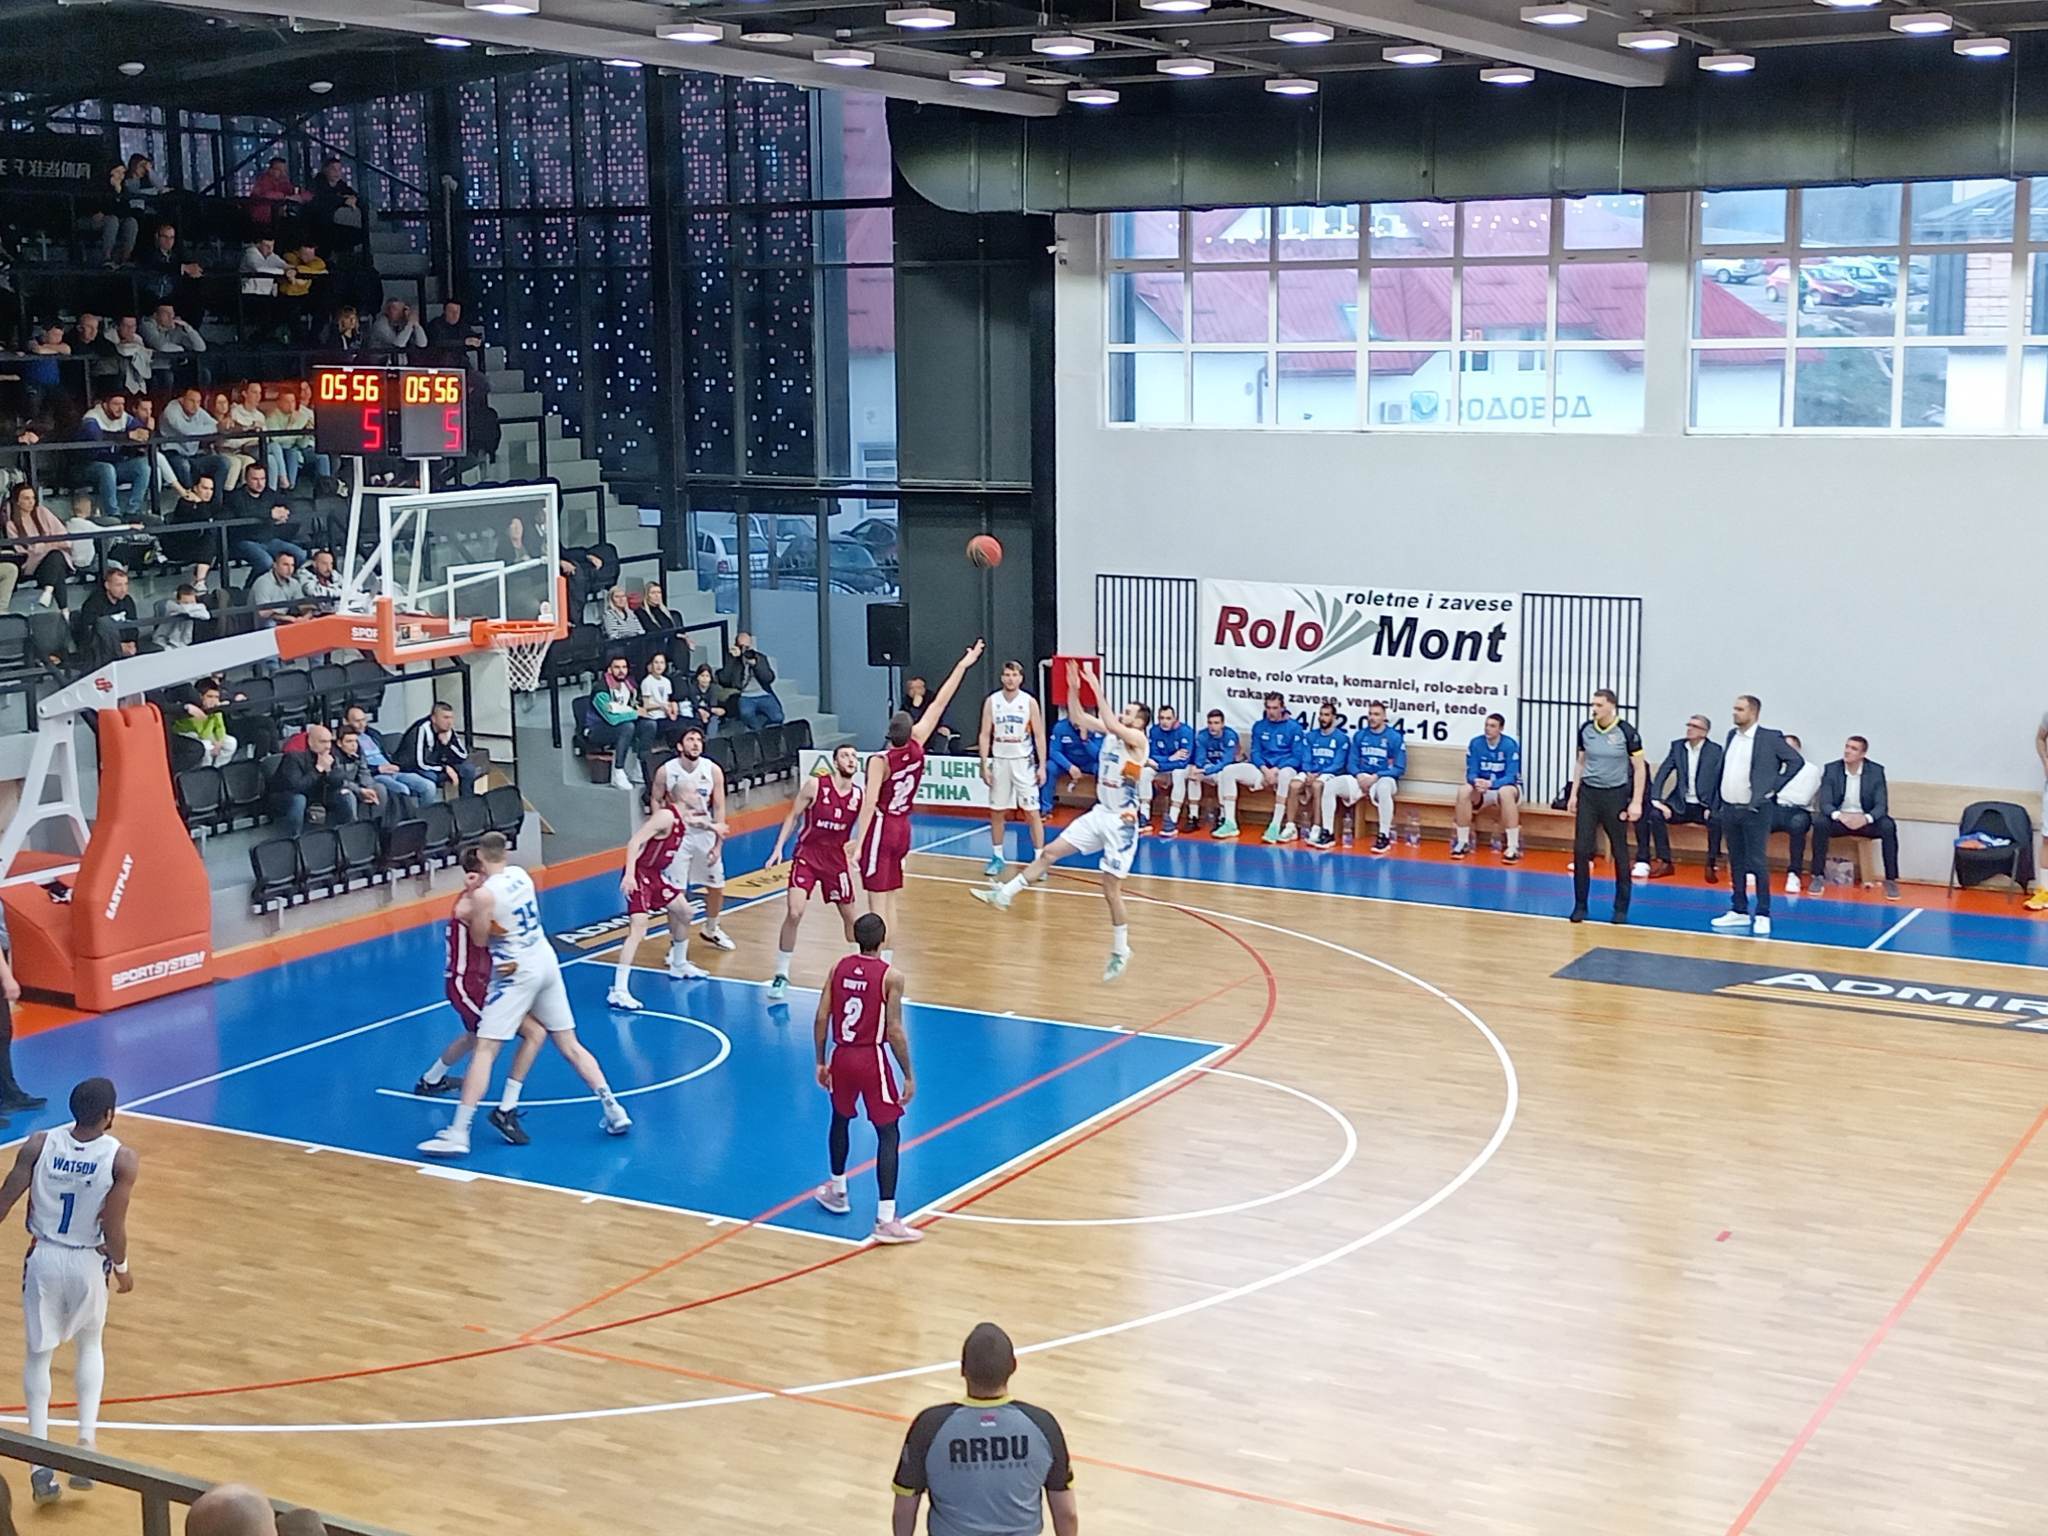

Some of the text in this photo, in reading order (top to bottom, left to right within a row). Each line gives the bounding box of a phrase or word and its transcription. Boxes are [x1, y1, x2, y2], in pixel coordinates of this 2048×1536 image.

[363, 407, 382, 449] 5
[444, 409, 461, 449] 5
[1345, 590, 1513, 612] roletne i zavese
[1214, 605, 1507, 663] Rolo Mont
[1208, 666, 1508, 696] roletne, rolo vrata, komarnici, rolo-zebra i
[1445, 702, 1487, 715] tende
[512, 901, 538, 936] 35
[111, 950, 206, 987] SPORTSYSTEM
[841, 996, 863, 1042] 2
[53, 1156, 98, 1175] WATSON
[57, 1192, 75, 1234] 1
[949, 1435, 1029, 1464] ARDU
